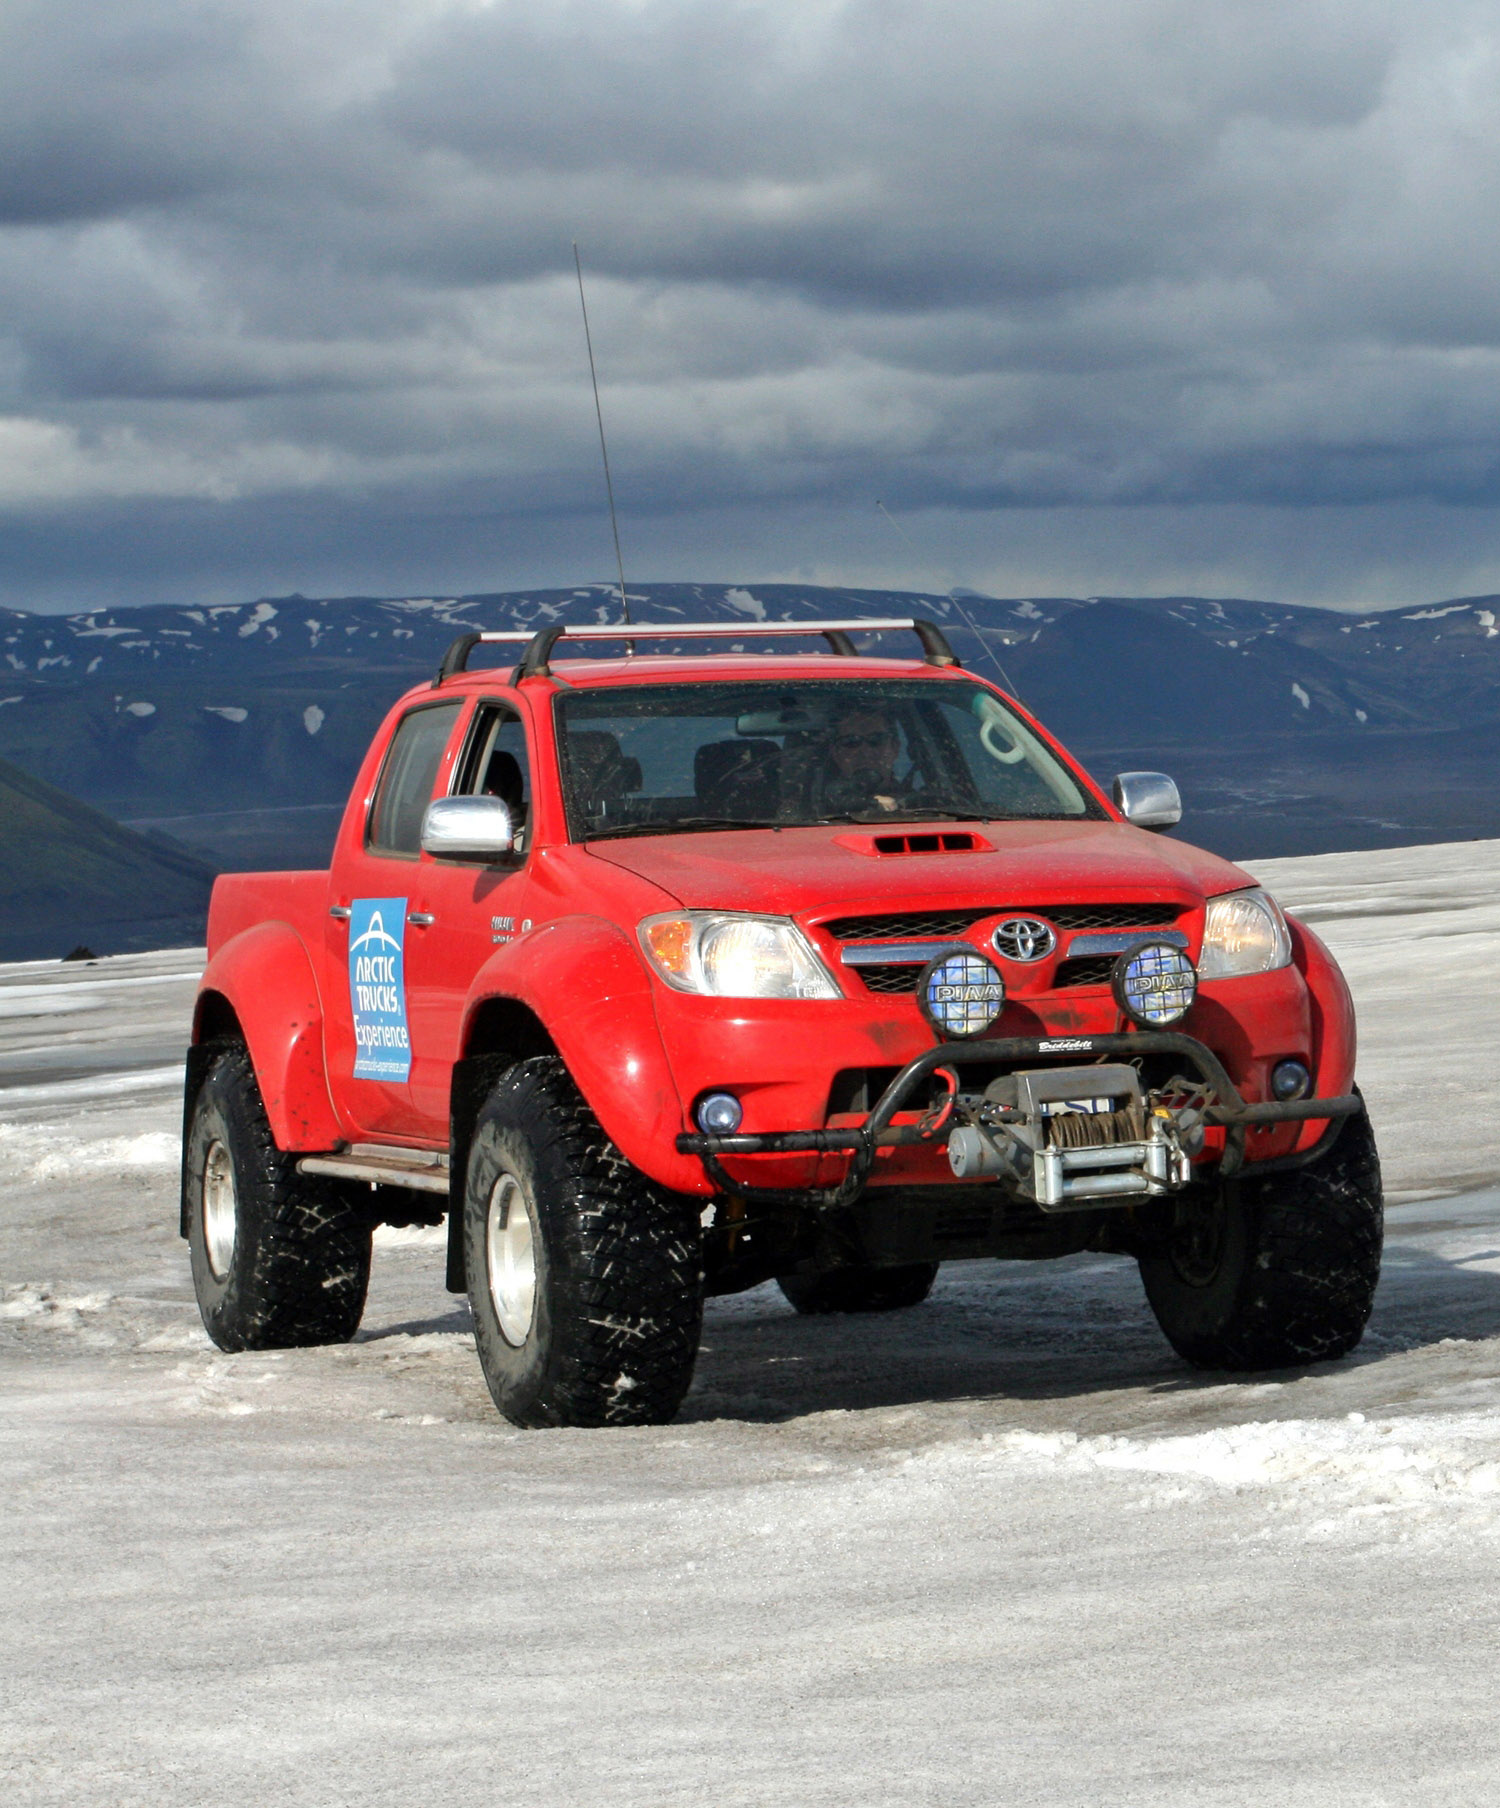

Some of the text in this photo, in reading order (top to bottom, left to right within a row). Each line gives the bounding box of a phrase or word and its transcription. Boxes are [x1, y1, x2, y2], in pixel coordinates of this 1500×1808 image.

[356, 956, 396, 983] ARCTIC
[937, 984, 1000, 1001] PIAA
[1135, 972, 1195, 993] PIAA
[354, 1014, 409, 1056] Experience
